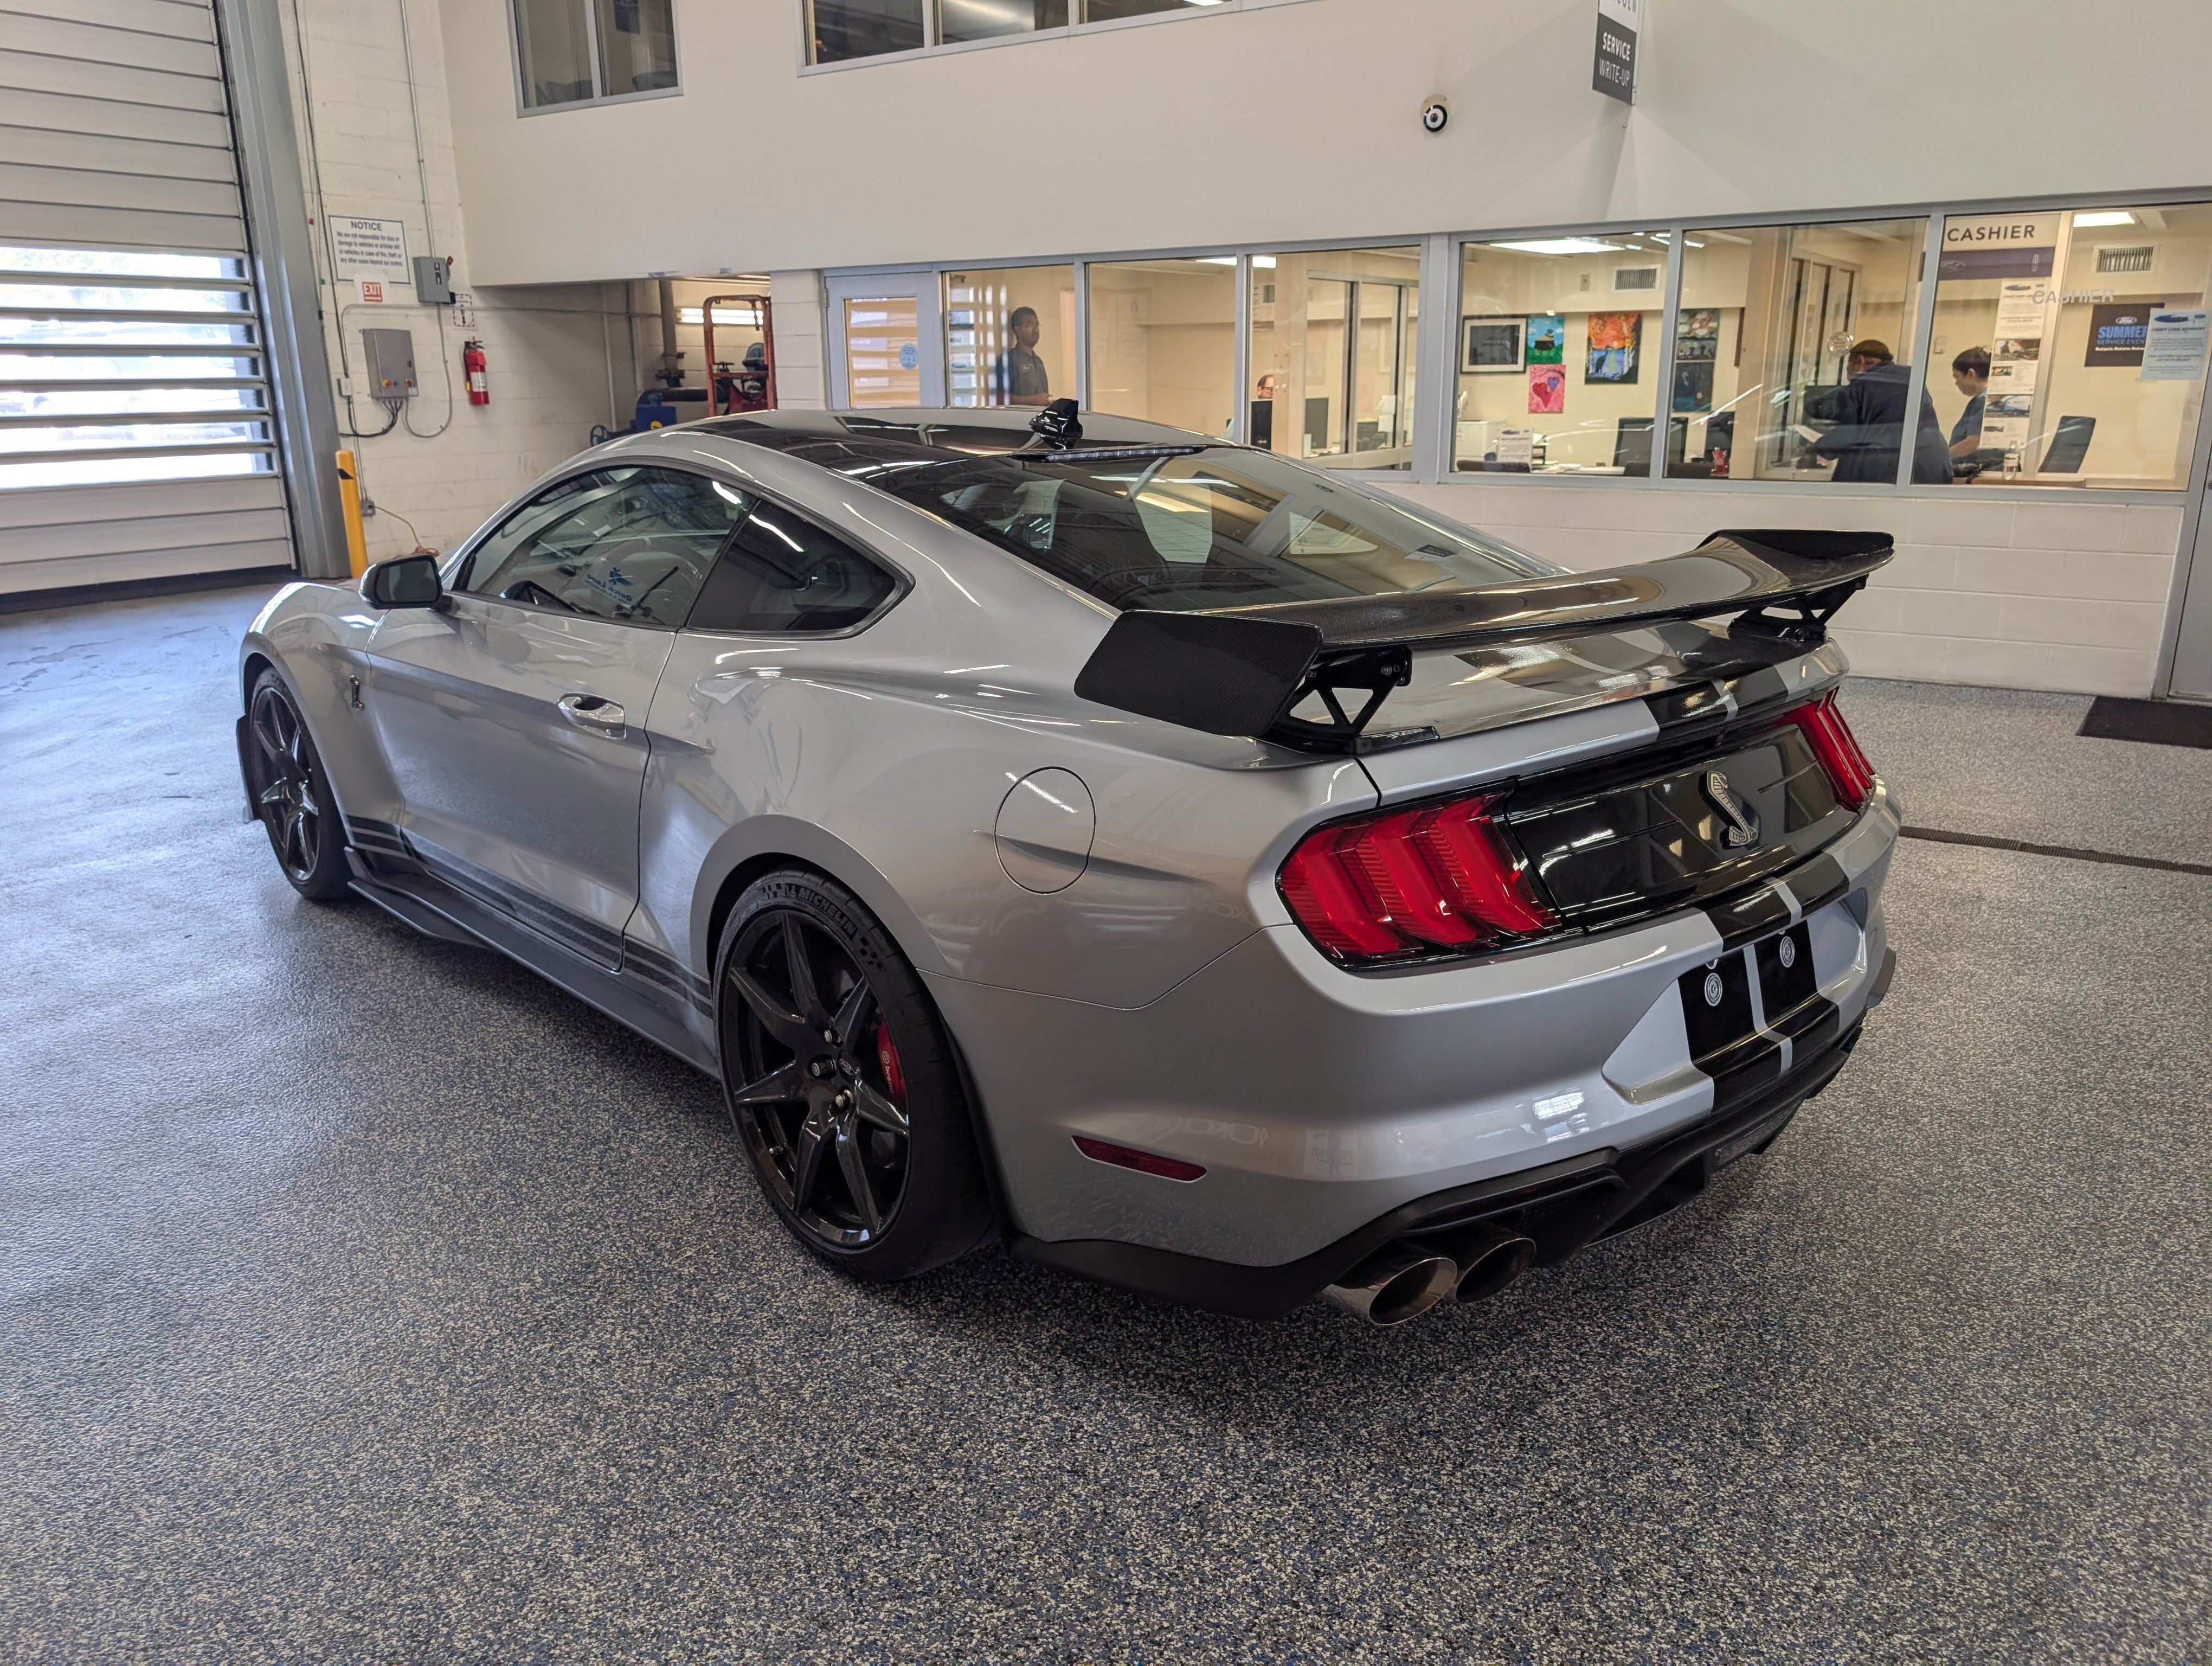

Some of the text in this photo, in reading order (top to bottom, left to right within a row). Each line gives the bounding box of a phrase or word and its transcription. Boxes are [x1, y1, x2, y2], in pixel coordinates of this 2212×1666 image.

[1602, 31, 1631, 61] SERVICE
[1599, 57, 1630, 87] WRITE-UP
[350, 221, 382, 231] NOTICE
[1947, 225, 2035, 241] CASHIER
[364, 284, 381, 296] EXIT
[2033, 287, 2114, 304] CASHIER
[798, 887, 858, 936] MICHELIN
